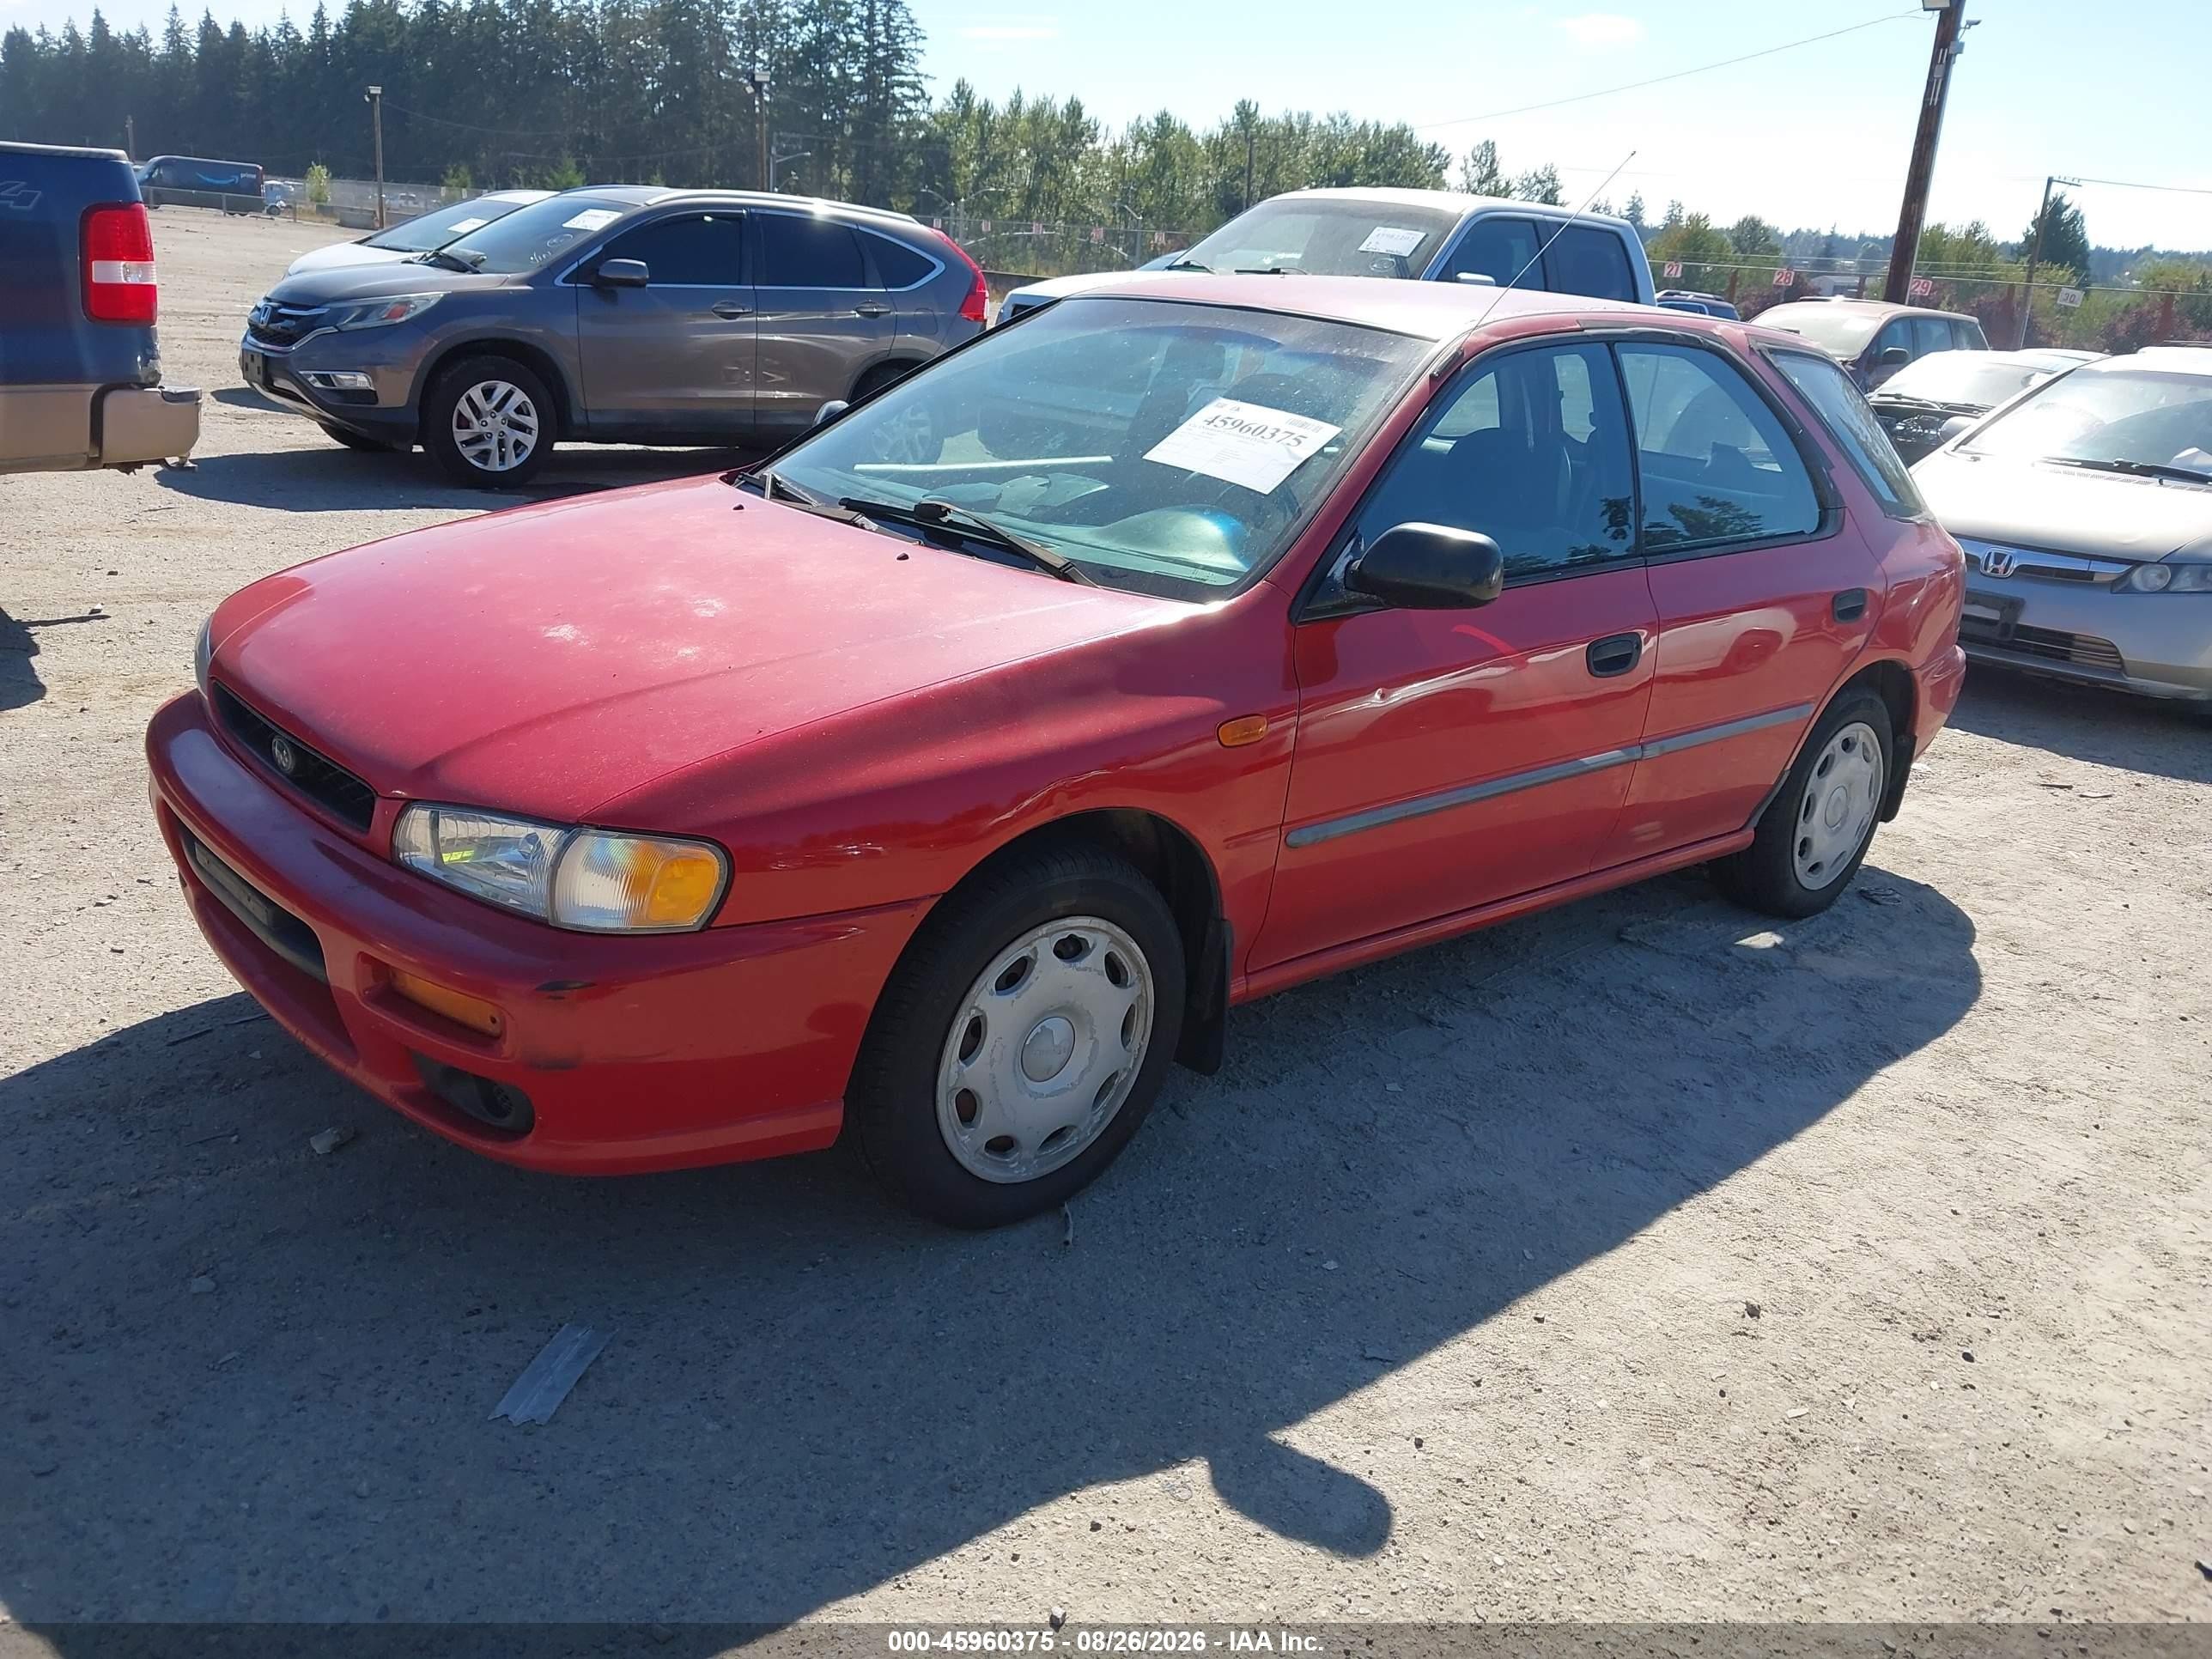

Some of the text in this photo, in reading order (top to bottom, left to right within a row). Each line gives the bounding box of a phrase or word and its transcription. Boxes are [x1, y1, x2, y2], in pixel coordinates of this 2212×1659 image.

[1666, 263, 1680, 276] 27
[1776, 271, 1792, 284] 28
[1911, 279, 1929, 294] 29
[2063, 293, 2075, 303] 30
[1203, 414, 1308, 447] 45960375
